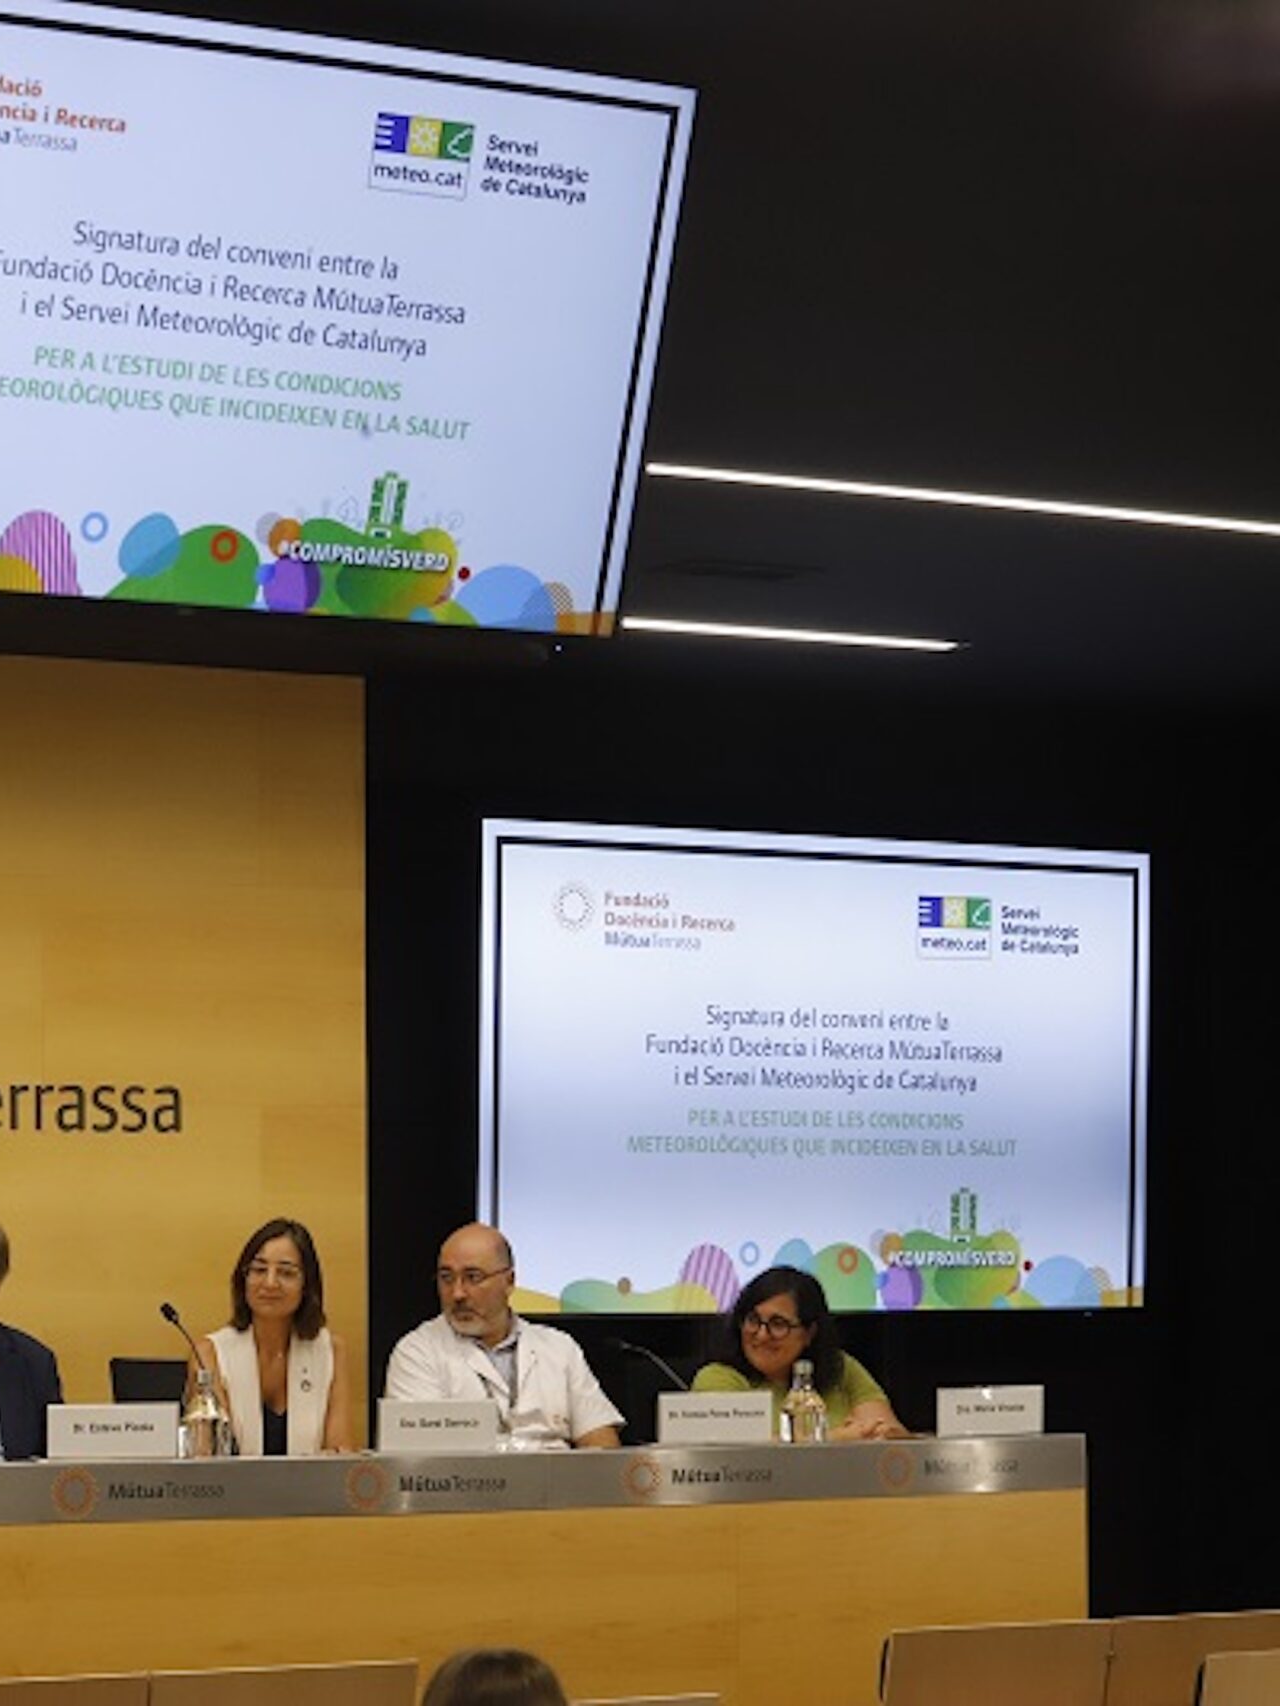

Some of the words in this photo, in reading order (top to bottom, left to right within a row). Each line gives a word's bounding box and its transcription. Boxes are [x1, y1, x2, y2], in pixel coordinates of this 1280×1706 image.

[44, 105, 49, 124] i
[55, 108, 126, 133] Recerca
[487, 134, 539, 157] Servei
[374, 164, 462, 188] meteo.cat
[481, 177, 502, 193] de
[506, 179, 587, 205] Catalunya
[73, 220, 180, 256] Signatura
[186, 234, 222, 260] del
[227, 244, 312, 270] conveni
[318, 255, 375, 278] entre
[380, 256, 399, 280] la
[102, 262, 202, 295] Docència
[210, 275, 217, 297] i
[223, 275, 306, 308] Recerca
[313, 285, 466, 324] MútuaTerrassa
[21, 291, 28, 314] i
[34, 294, 55, 317] el
[61, 296, 130, 324] Servei
[136, 304, 282, 346] Meteorològic
[288, 321, 316, 346] de
[323, 323, 427, 362] Catalunya
[34, 345, 76, 369] PER
[80, 352, 96, 371] A
[198, 361, 226, 384] DE
[233, 366, 270, 389] LES
[274, 370, 402, 402] CONDICIONS
[170, 393, 213, 418] QUE
[219, 398, 337, 428] INCIDEIXEN
[341, 408, 369, 431] EN
[374, 413, 402, 434] LA
[405, 415, 470, 441] SALUT
[706, 1004, 785, 1031] Signatura
[790, 1008, 816, 1028] del
[821, 1010, 884, 1029] conveni
[889, 1013, 931, 1031] entre
[937, 1012, 949, 1031] la
[646, 1033, 724, 1056] Fundació
[812, 1037, 817, 1057] i
[822, 1037, 884, 1060] Recerca
[674, 1065, 680, 1086] i
[684, 1065, 698, 1086] el
[703, 1065, 756, 1086] Servei
[873, 1069, 894, 1089] de
[899, 1070, 977, 1096] Catalunya
[688, 1109, 719, 1126] PER
[723, 1110, 734, 1127] A
[812, 1111, 833, 1128] DE
[838, 1111, 864, 1128] LES
[870, 1111, 964, 1131] CONDICIONS
[946, 1139, 968, 1157] LA
[970, 1139, 1017, 1158] SALUT
[108, 1481, 225, 1500] MútuaTerrassa
